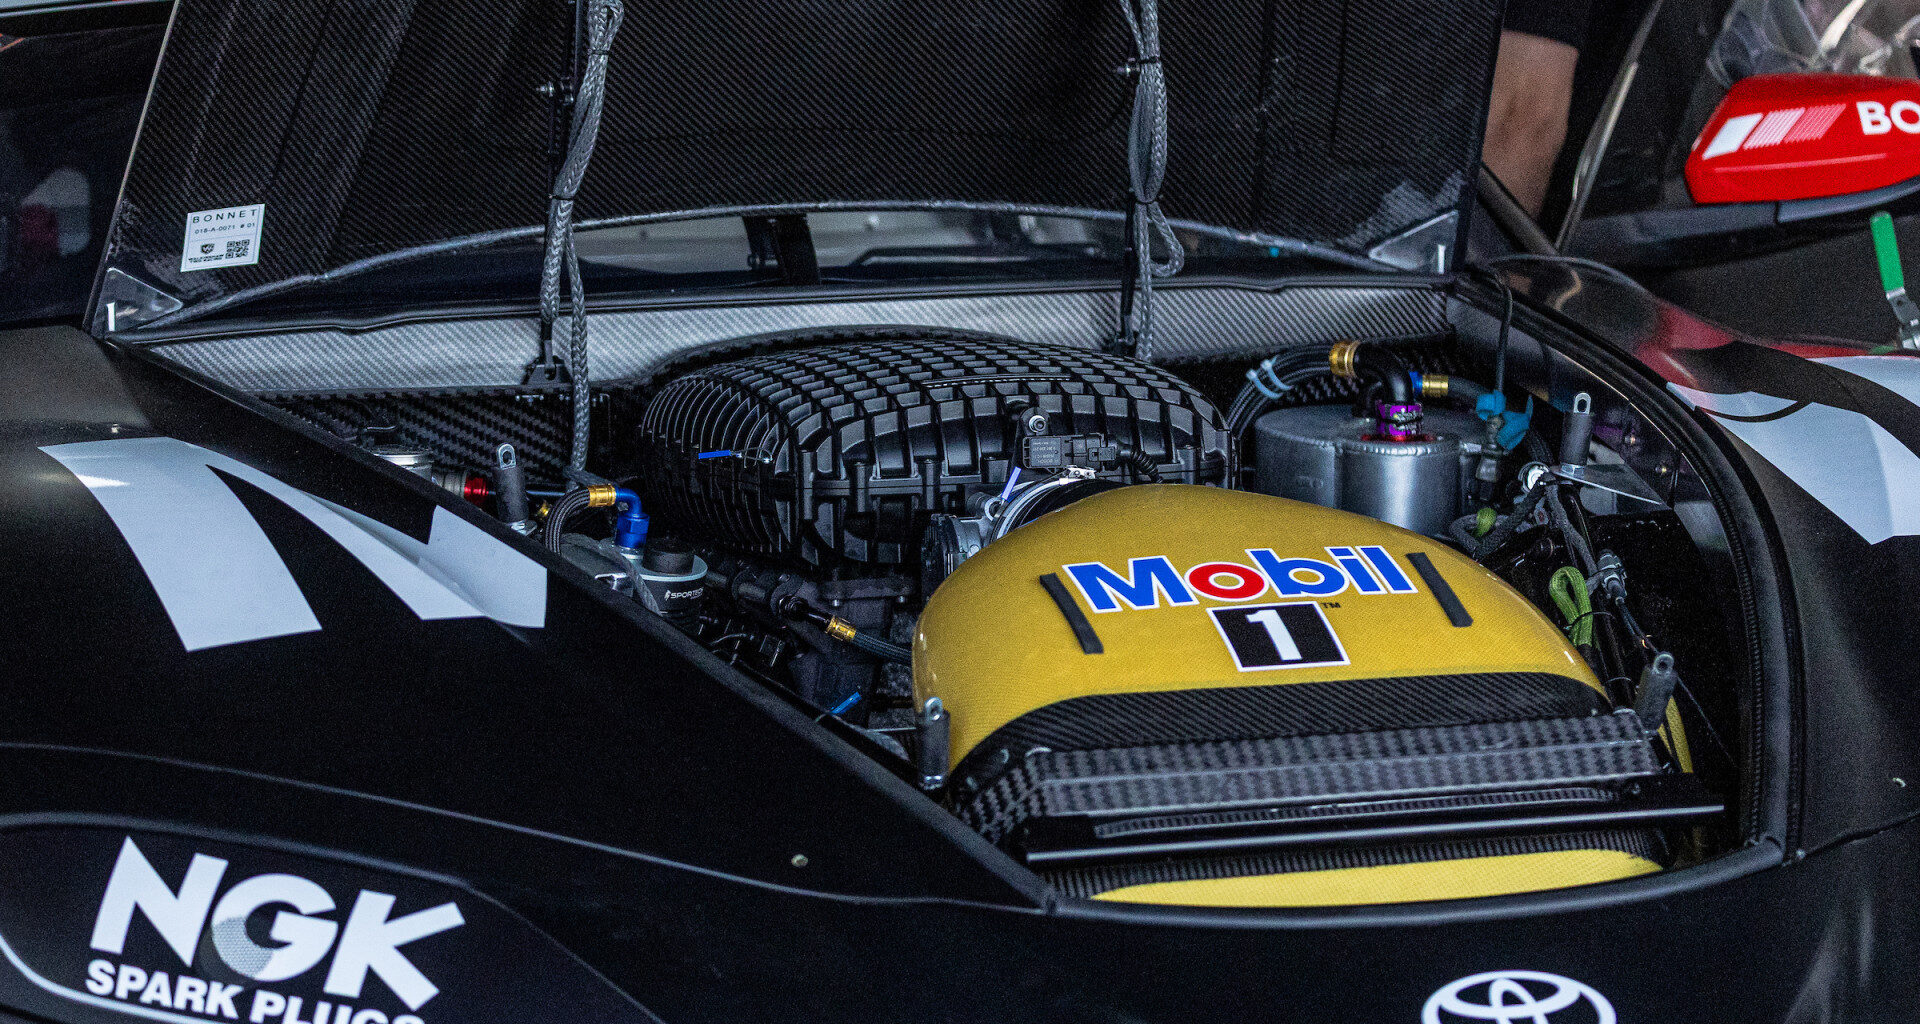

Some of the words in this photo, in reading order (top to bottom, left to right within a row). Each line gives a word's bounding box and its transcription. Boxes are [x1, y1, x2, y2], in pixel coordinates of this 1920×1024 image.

[192, 209, 257, 224] BONNET
[1062, 545, 1418, 613] Mobil
[1246, 609, 1302, 661] 1
[89, 835, 466, 1012] NGK
[85, 959, 244, 1021] SPARK
[249, 988, 426, 1024] PLU
